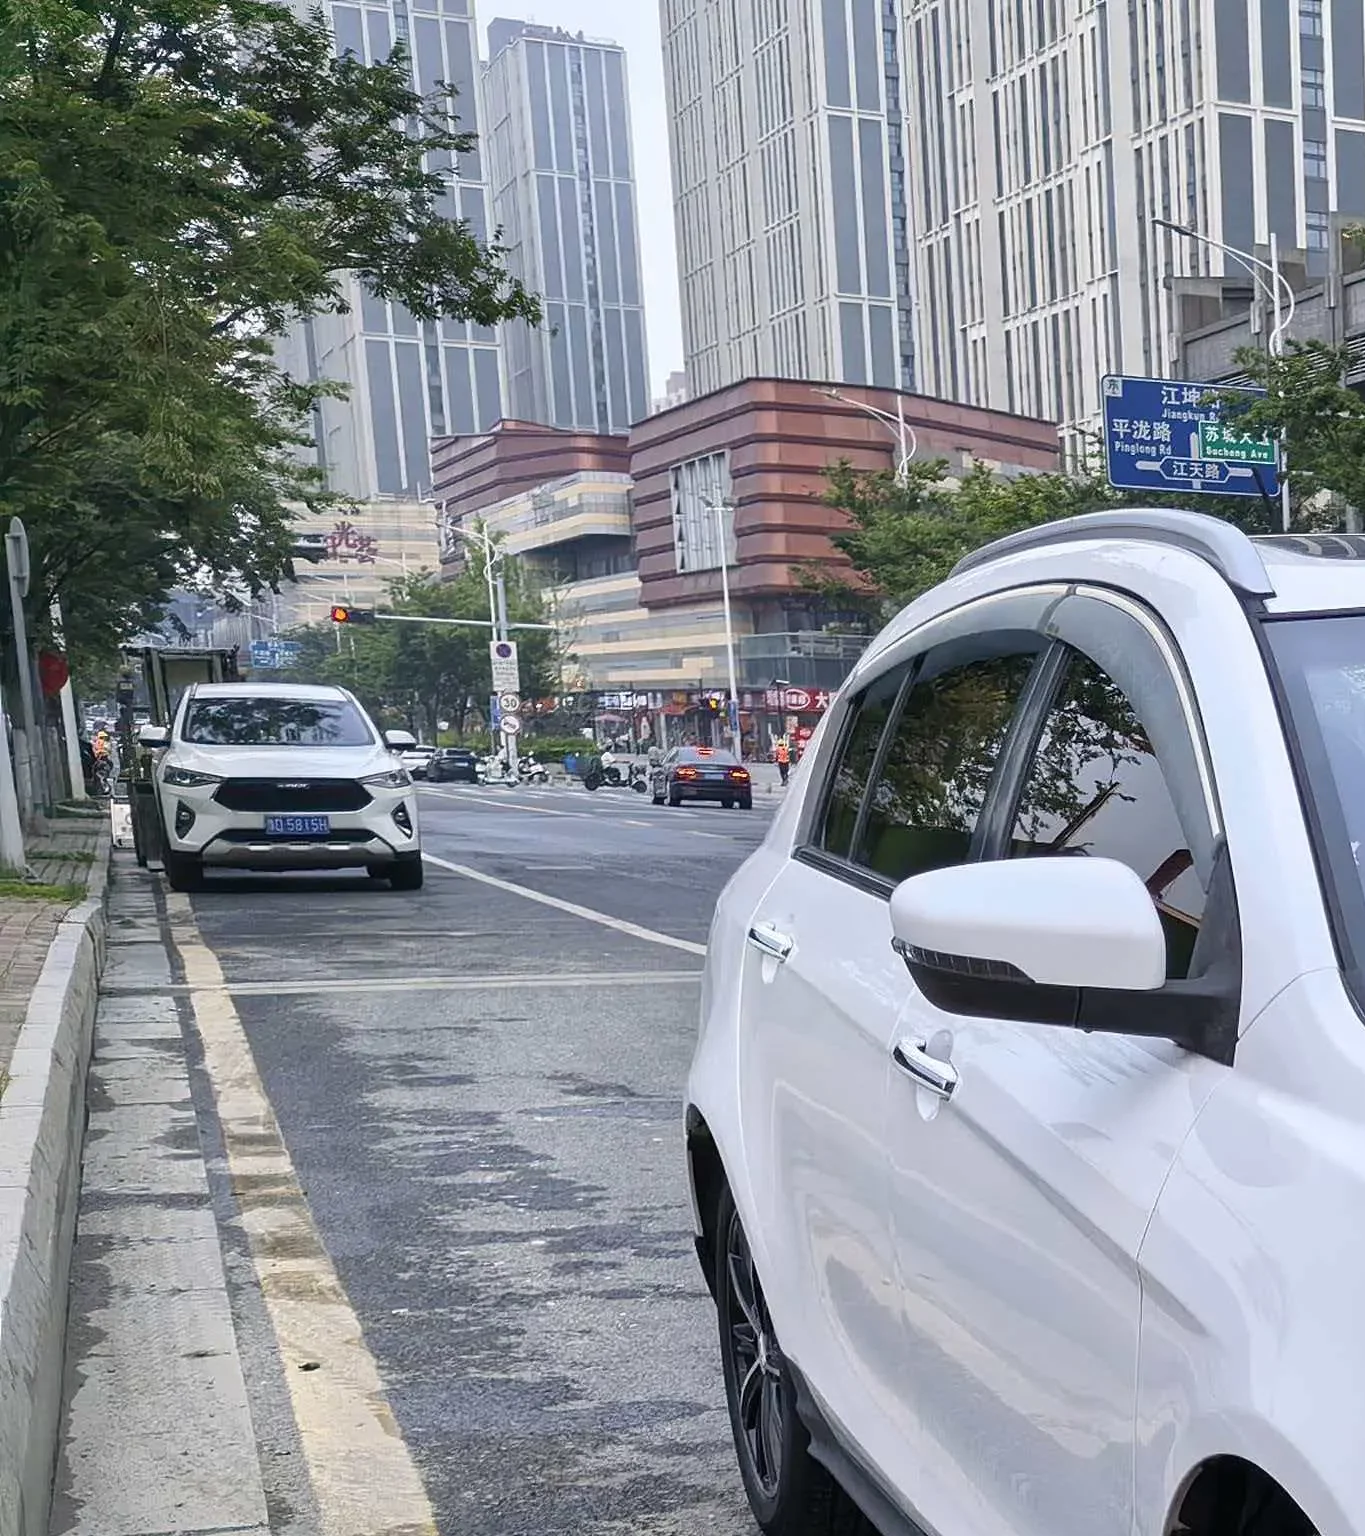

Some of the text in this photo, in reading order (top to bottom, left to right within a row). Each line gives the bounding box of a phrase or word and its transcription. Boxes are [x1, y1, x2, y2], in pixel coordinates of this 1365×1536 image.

[1161, 408, 1220, 422] Jiangkun R
[1112, 418, 1173, 443] 平泷路
[1114, 440, 1172, 457] Pinglong Rd
[1206, 446, 1269, 459] Sucheng Ave
[1172, 461, 1221, 480] 江天路
[503, 697, 517, 709] 30
